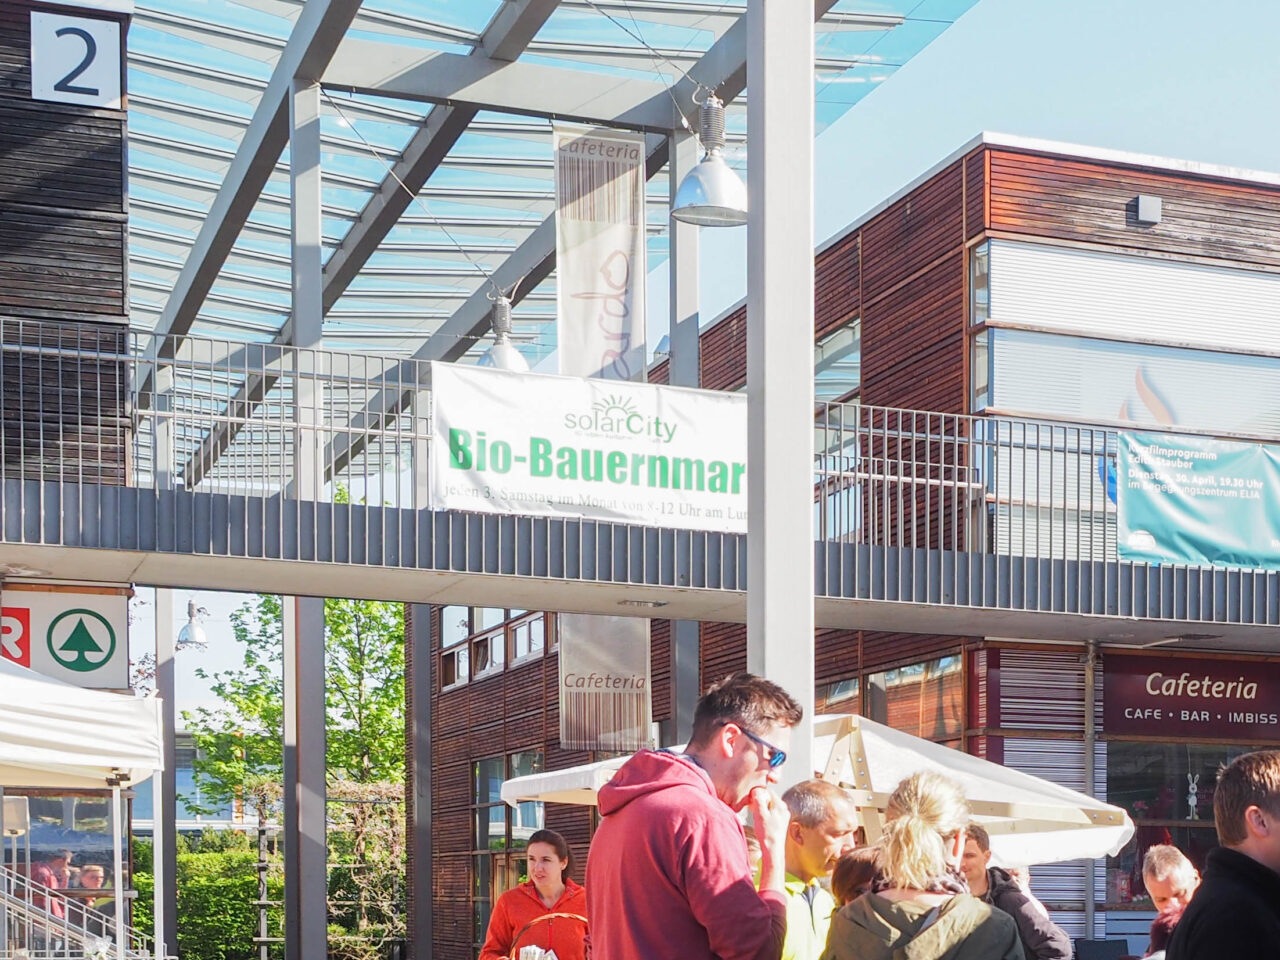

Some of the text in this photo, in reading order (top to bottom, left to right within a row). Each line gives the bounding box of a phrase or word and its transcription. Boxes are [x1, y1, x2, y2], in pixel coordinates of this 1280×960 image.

[54, 27, 99, 96] 2
[558, 137, 640, 161] Cafeteria
[564, 409, 677, 443] solarCity
[449, 427, 746, 495] Bio-Bauernmar
[1128, 442, 1217, 461] Kzfilmprogramm
[1128, 454, 1194, 470] Edi tauber
[1128, 481, 1140, 489] im
[1142, 482, 1238, 499] Bgegungszentrum
[1192, 475, 1217, 488] April,
[1246, 479, 1265, 490] Uhr
[442, 483, 479, 498] jeden
[484, 486, 496, 500] 3.
[500, 487, 554, 505] Samstag
[557, 493, 574, 505] im
[578, 494, 618, 511] Monat
[622, 501, 644, 513] von
[679, 503, 702, 518] Uhr
[705, 508, 724, 519] am
[564, 672, 646, 689] Cafeteria
[1145, 672, 1258, 700] Cafeteria
[1124, 708, 1278, 724] CAFE BAR IMBISS
